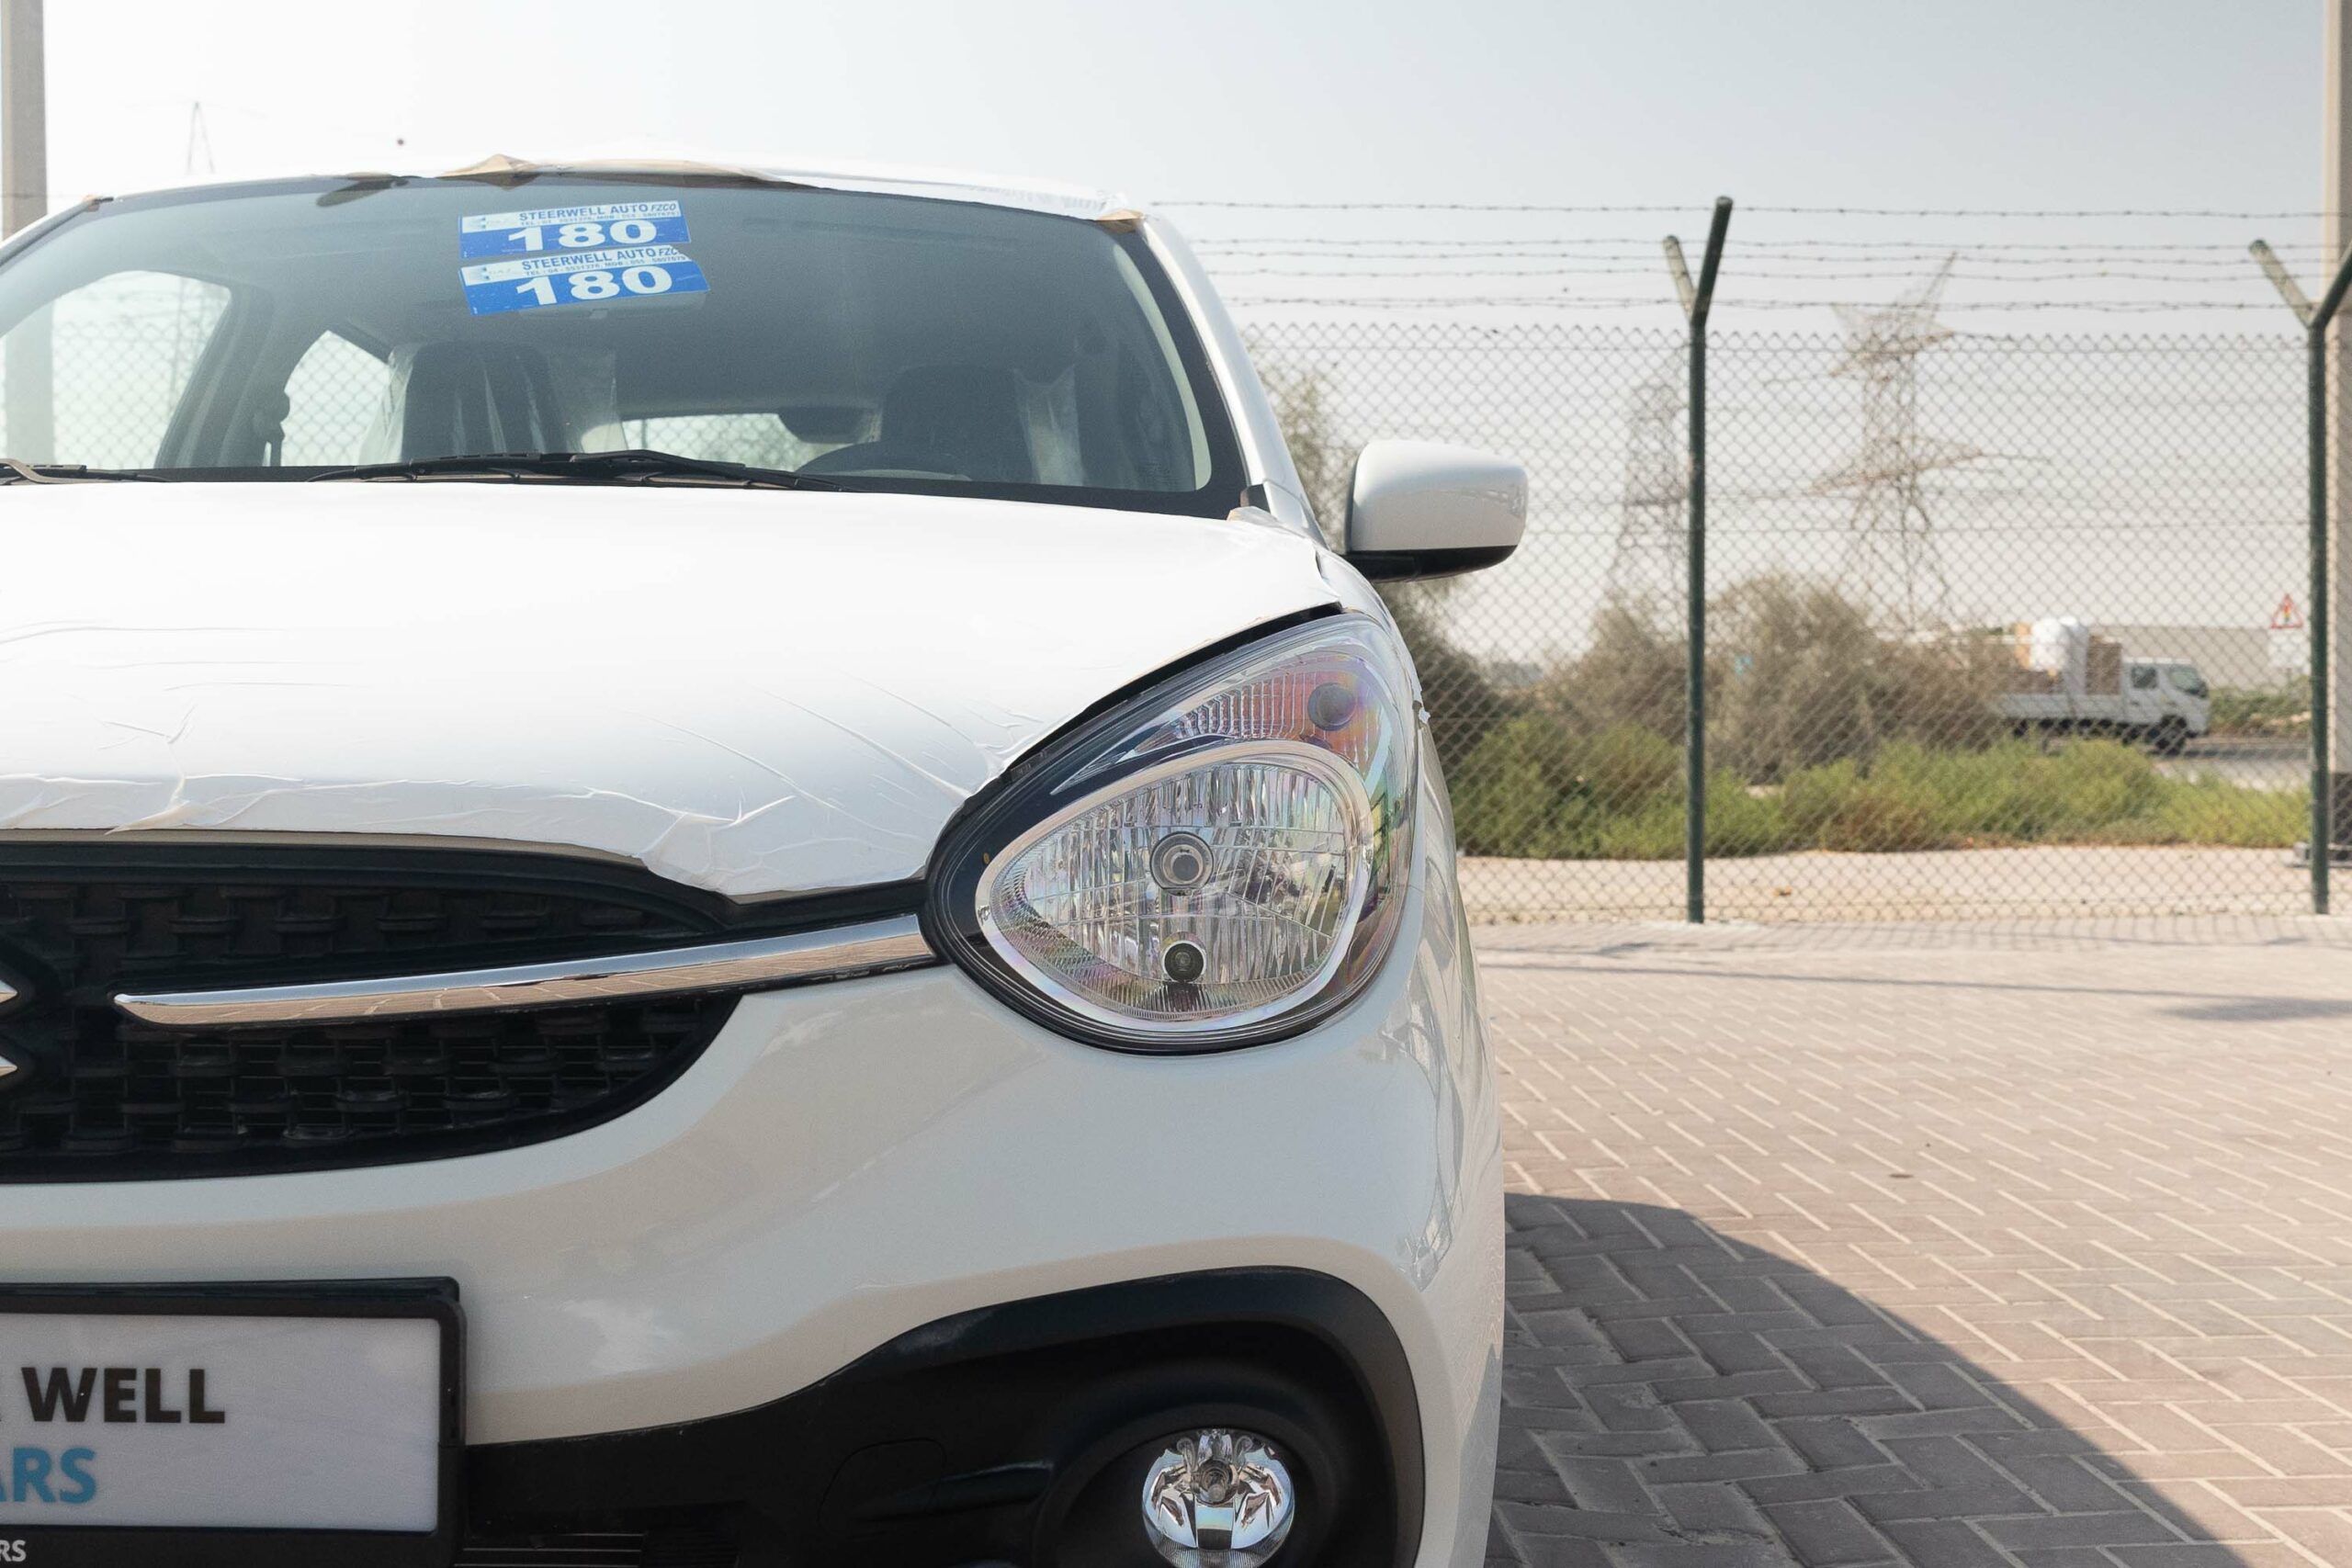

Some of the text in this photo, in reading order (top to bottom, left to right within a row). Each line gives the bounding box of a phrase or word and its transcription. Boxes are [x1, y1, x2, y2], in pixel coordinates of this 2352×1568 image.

[519, 206, 605, 221] STEERWELL
[610, 203, 649, 214] AUTO
[650, 203, 677, 213] FZCO
[508, 220, 658, 252] 180
[522, 247, 680, 271] STEERWELL AUTO FZC
[515, 265, 673, 306] 180
[20, 1366, 226, 1425] WELL
[0, 1448, 96, 1503] RS
